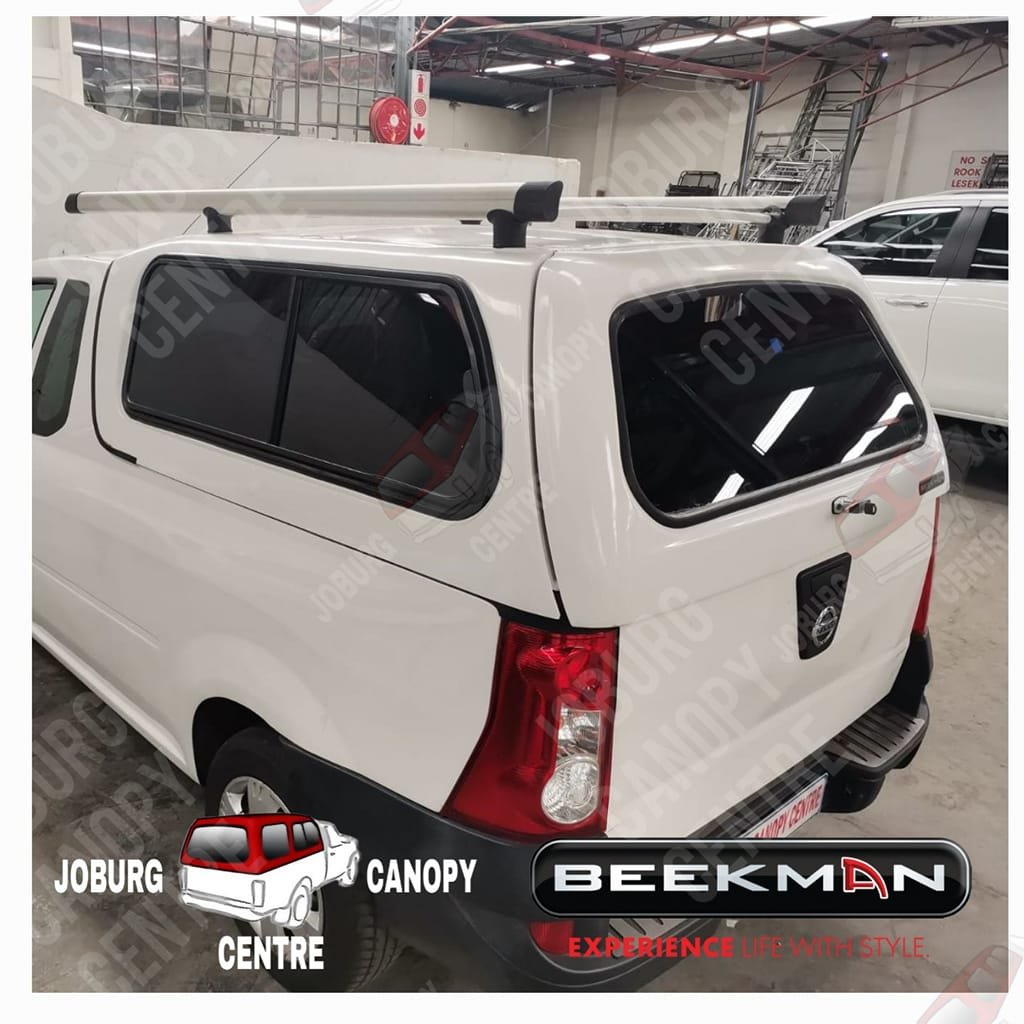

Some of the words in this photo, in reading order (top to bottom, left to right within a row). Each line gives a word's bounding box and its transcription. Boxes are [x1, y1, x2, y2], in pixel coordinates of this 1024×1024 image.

[960, 156, 976, 165] NO
[954, 167, 981, 176] ROOK
[951, 179, 979, 188] LESEK
